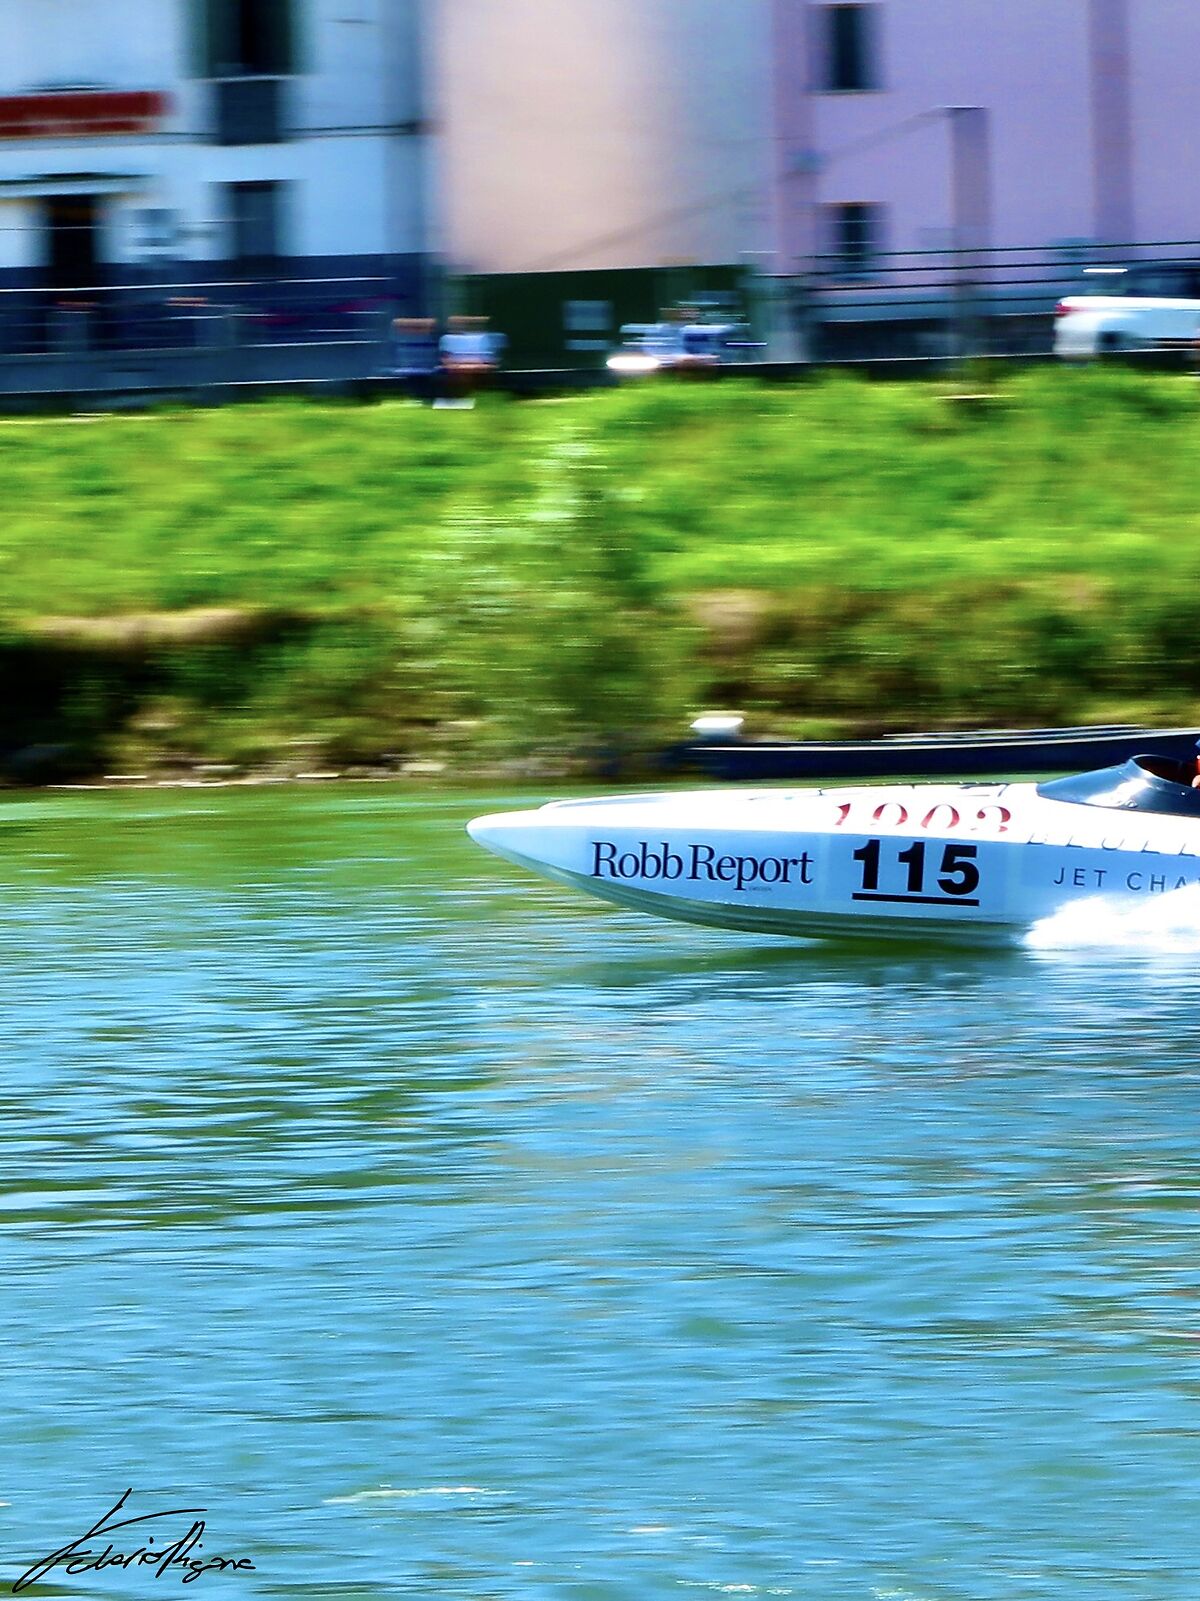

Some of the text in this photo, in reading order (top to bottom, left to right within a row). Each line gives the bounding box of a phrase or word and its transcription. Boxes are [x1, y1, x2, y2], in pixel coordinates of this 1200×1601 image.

[590, 841, 814, 891] Robb Report
[853, 839, 980, 895] 115
[1053, 867, 1108, 888] JET
